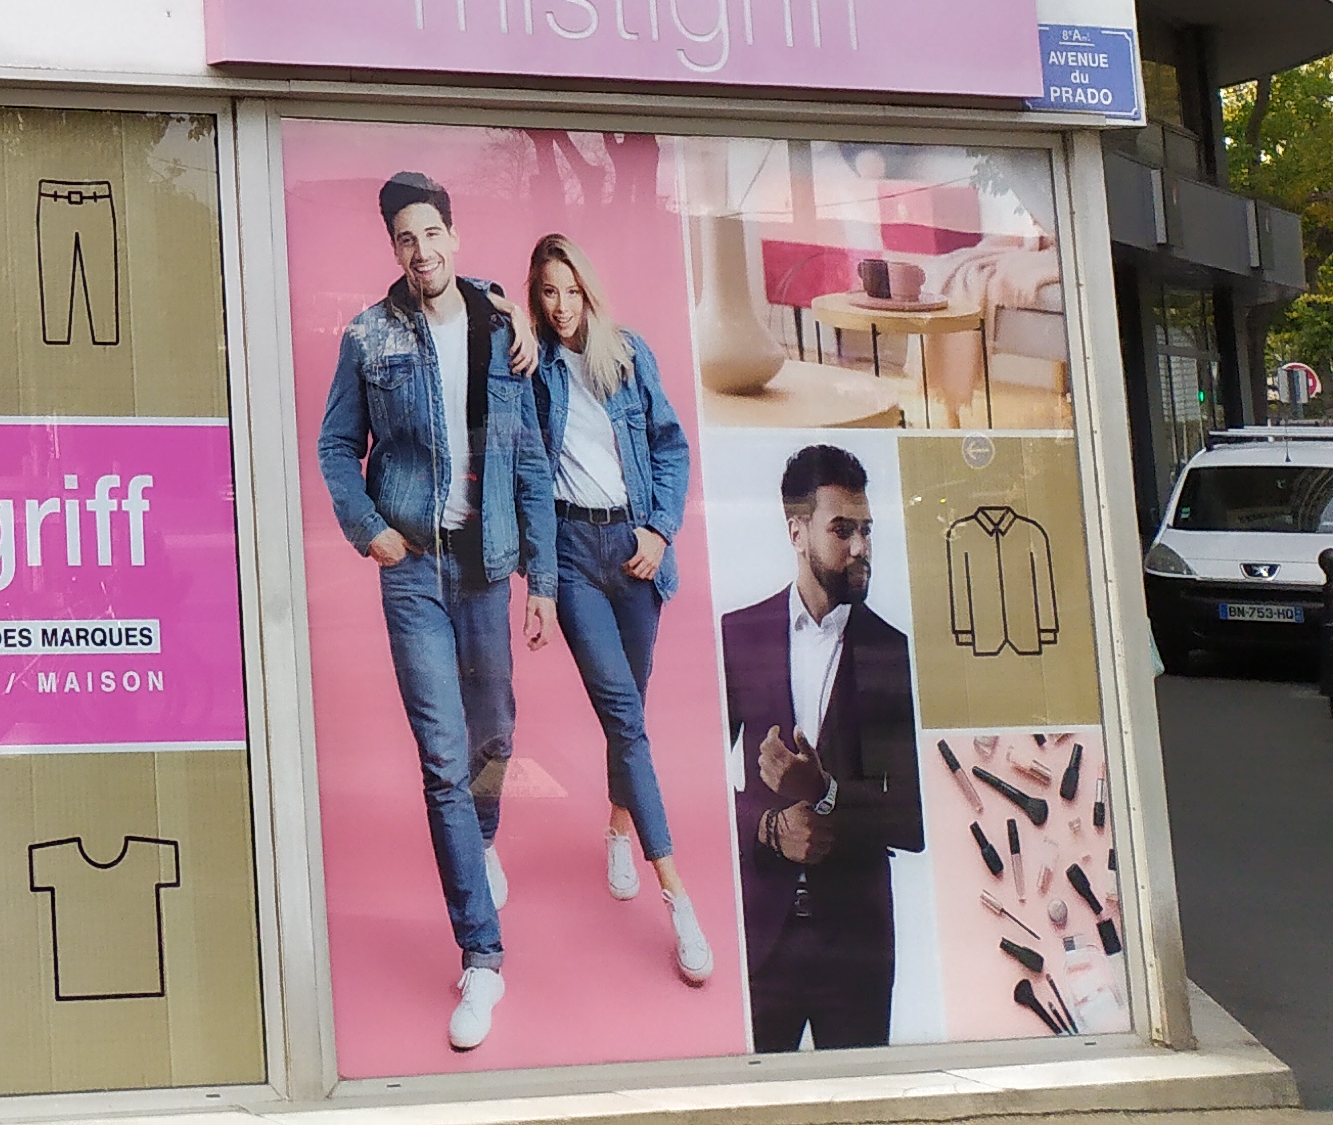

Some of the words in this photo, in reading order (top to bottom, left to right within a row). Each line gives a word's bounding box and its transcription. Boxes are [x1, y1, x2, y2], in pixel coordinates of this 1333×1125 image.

[1048, 50, 1109, 68] AVENUE
[1070, 70, 1090, 84] du
[1050, 86, 1113, 105] PRADO
[40, 626, 154, 648] MARQUES
[37, 670, 165, 695] MAISON
